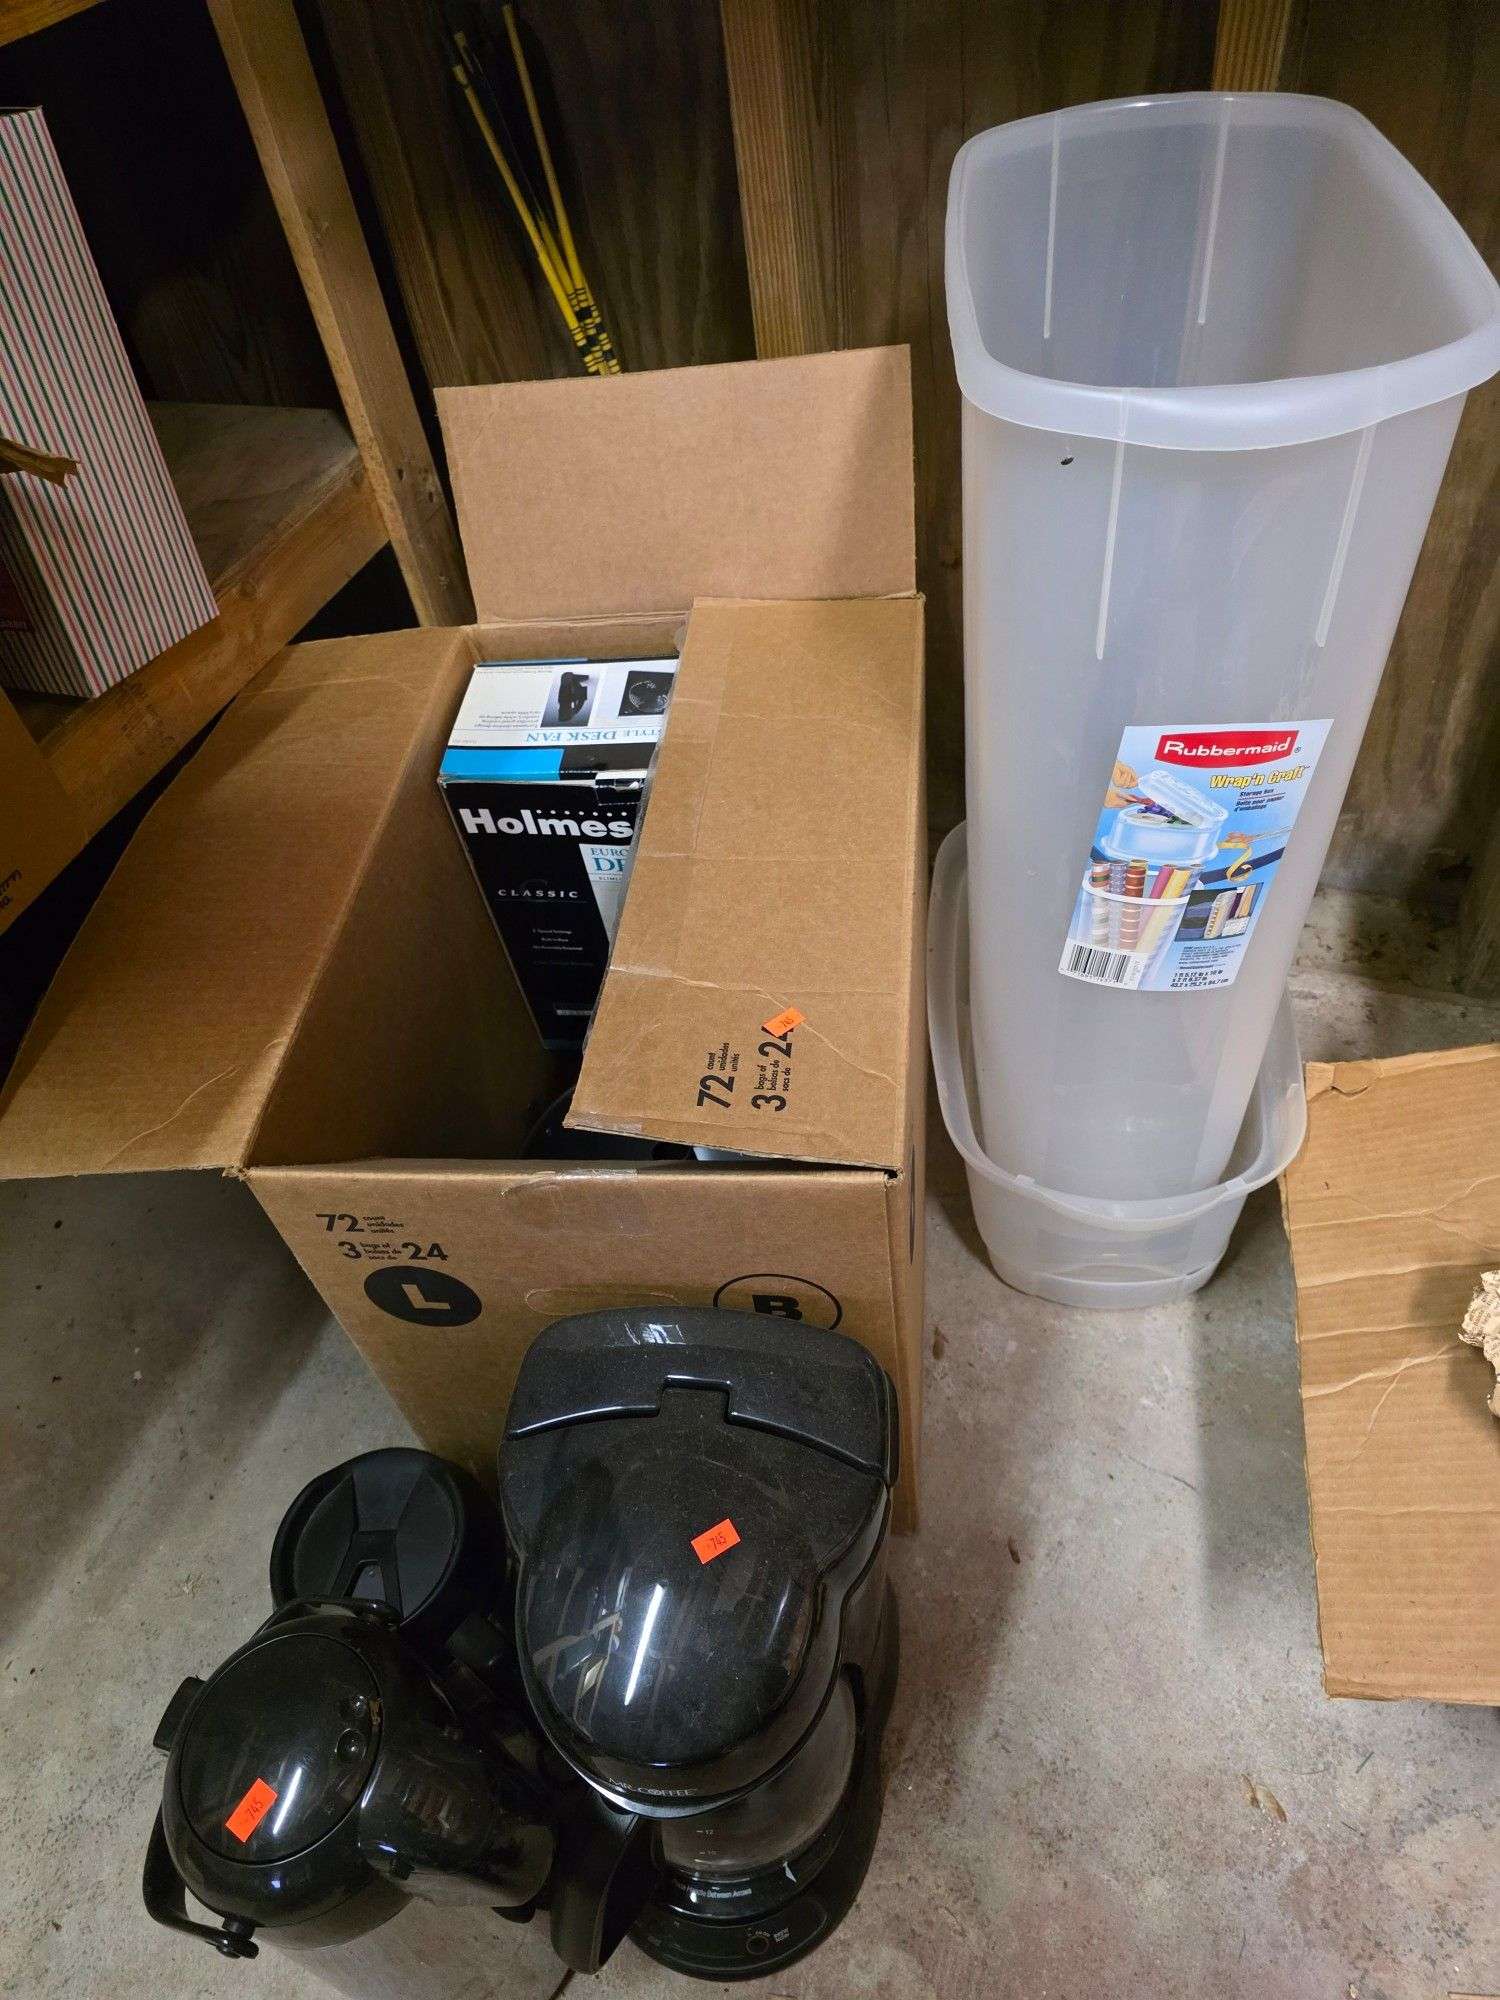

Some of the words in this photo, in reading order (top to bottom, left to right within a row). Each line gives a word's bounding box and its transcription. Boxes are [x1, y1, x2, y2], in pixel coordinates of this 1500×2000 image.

[526, 731, 561, 743] FAN
[567, 730, 616, 741] DESK
[1163, 736, 1292, 758] Rubbermaid
[1210, 774, 1265, 789] Wrap'n
[1267, 766, 1305, 785] Craft
[459, 808, 633, 838] Holmes
[498, 889, 579, 898] CLASSIC
[717, 1042, 730, 1072] unidades
[754, 1074, 768, 1090] bags
[766, 1069, 779, 1091] bolsas
[782, 1078, 791, 1092] sacs
[696, 1074, 735, 1109] 72
[750, 1094, 787, 1112] 3
[315, 1213, 364, 1232] 72
[338, 1241, 362, 1259] 3
[401, 1242, 448, 1261] 24
[400, 1283, 451, 1310] L
[752, 1294, 802, 1321] B
[637, 1786, 697, 1797] COFFEE
